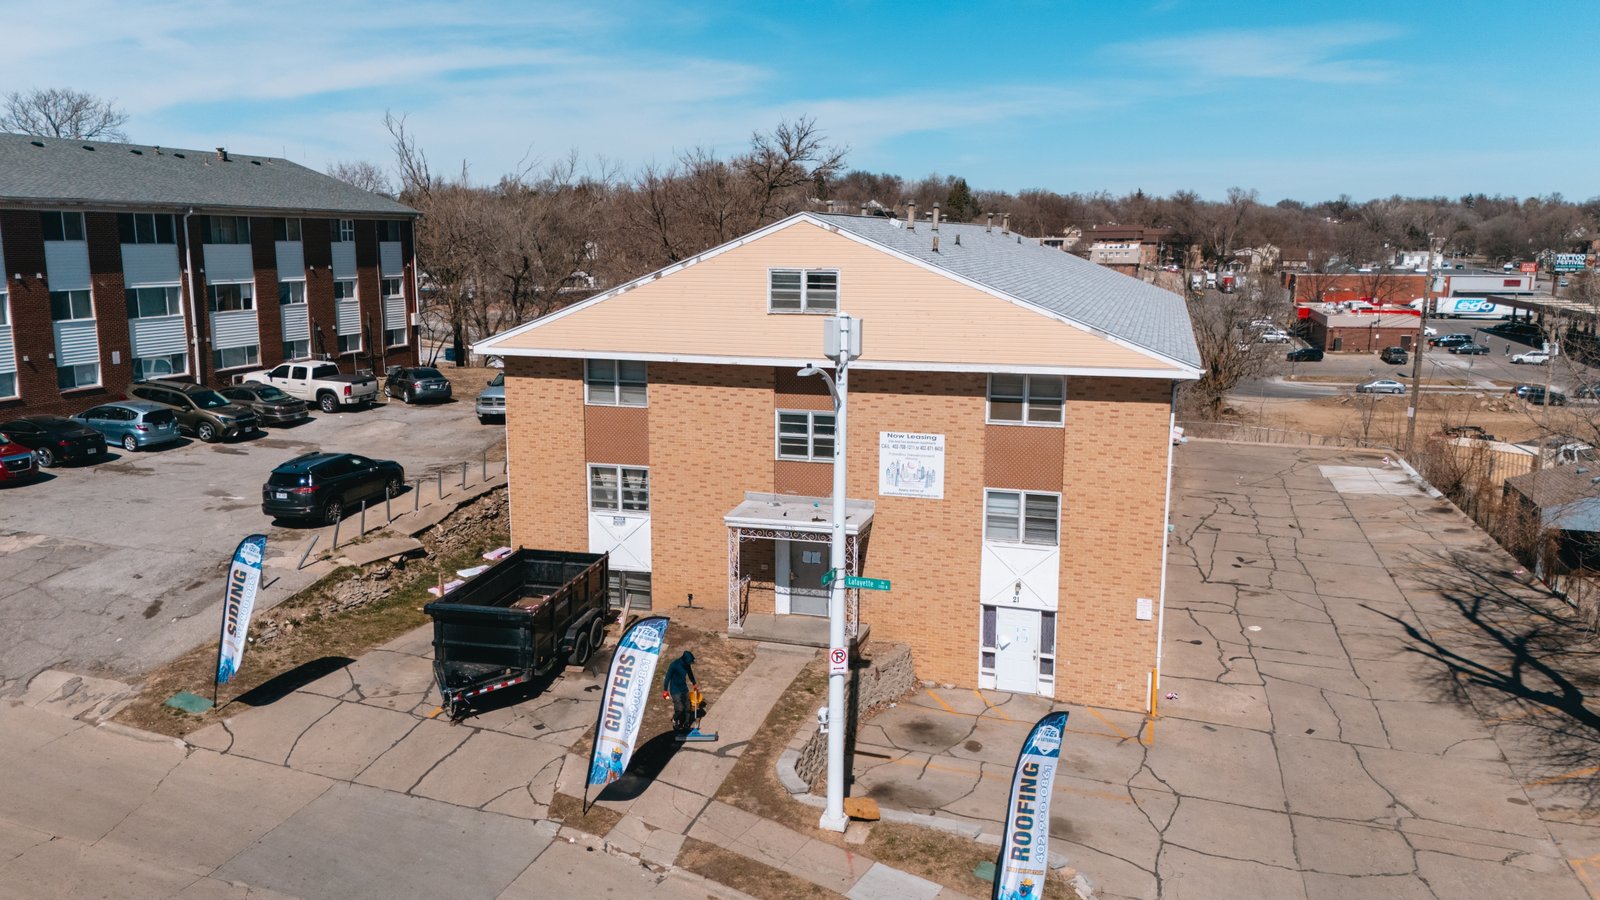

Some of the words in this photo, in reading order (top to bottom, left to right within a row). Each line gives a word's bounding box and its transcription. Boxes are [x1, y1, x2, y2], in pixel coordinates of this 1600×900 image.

[227, 569, 247, 638] SIDING
[848, 578, 874, 587] Lafayette
[605, 653, 636, 733] GUTTERS
[1011, 761, 1040, 862] ROOFING
[1034, 764, 1053, 864] 402-900-0861
